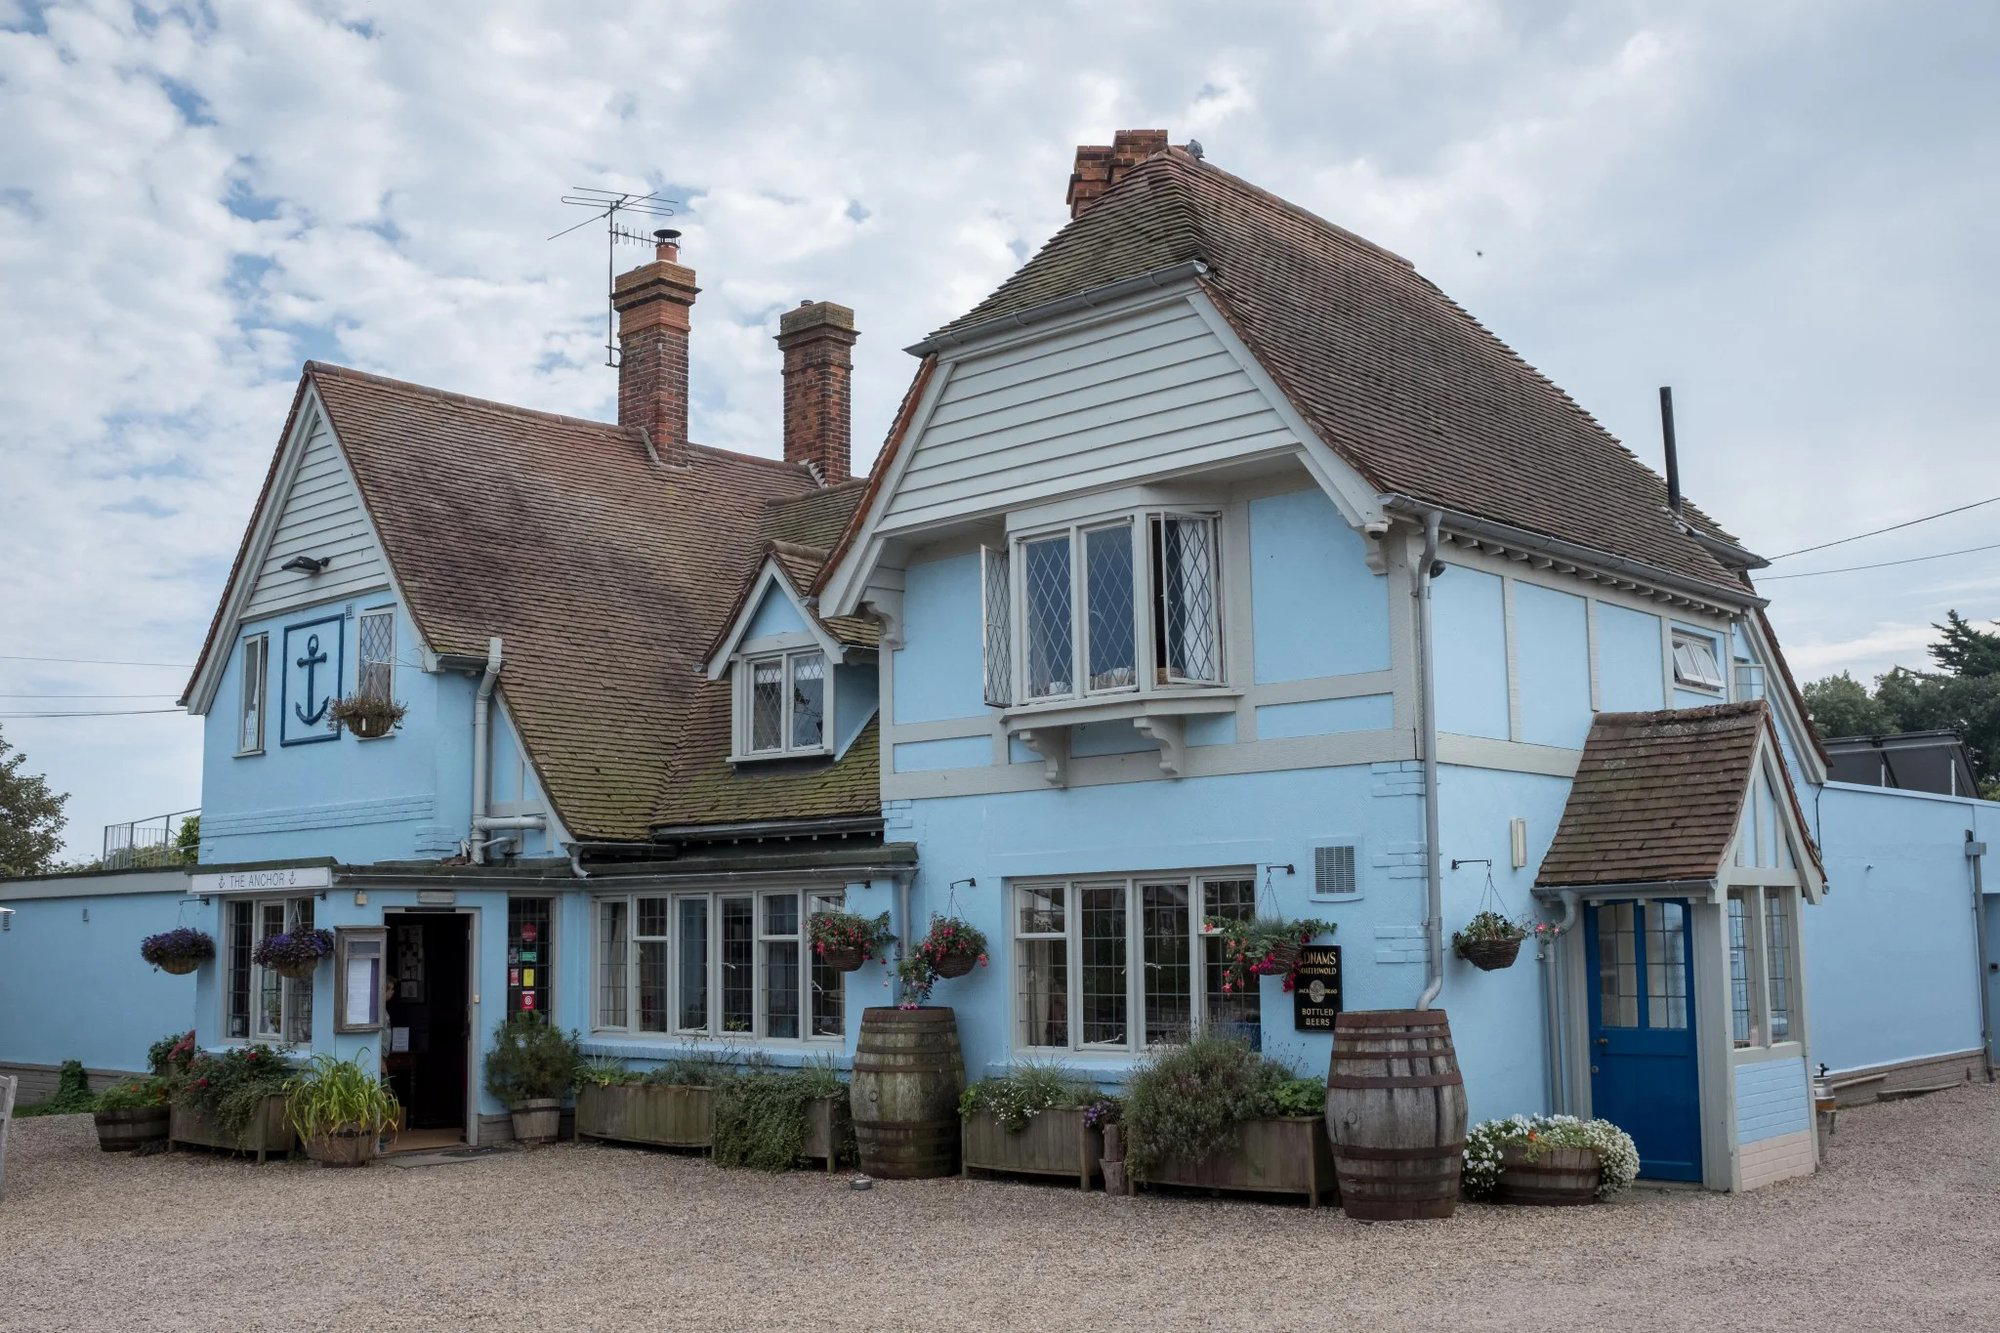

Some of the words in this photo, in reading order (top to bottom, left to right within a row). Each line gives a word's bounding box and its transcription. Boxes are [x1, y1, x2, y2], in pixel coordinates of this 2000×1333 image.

[230, 875, 245, 888] THE
[248, 872, 285, 887] ANCHOR
[1302, 951, 1337, 965] DNAMS
[1302, 1008, 1334, 1016] BOTTLED
[1305, 1018, 1330, 1026] BEERS
